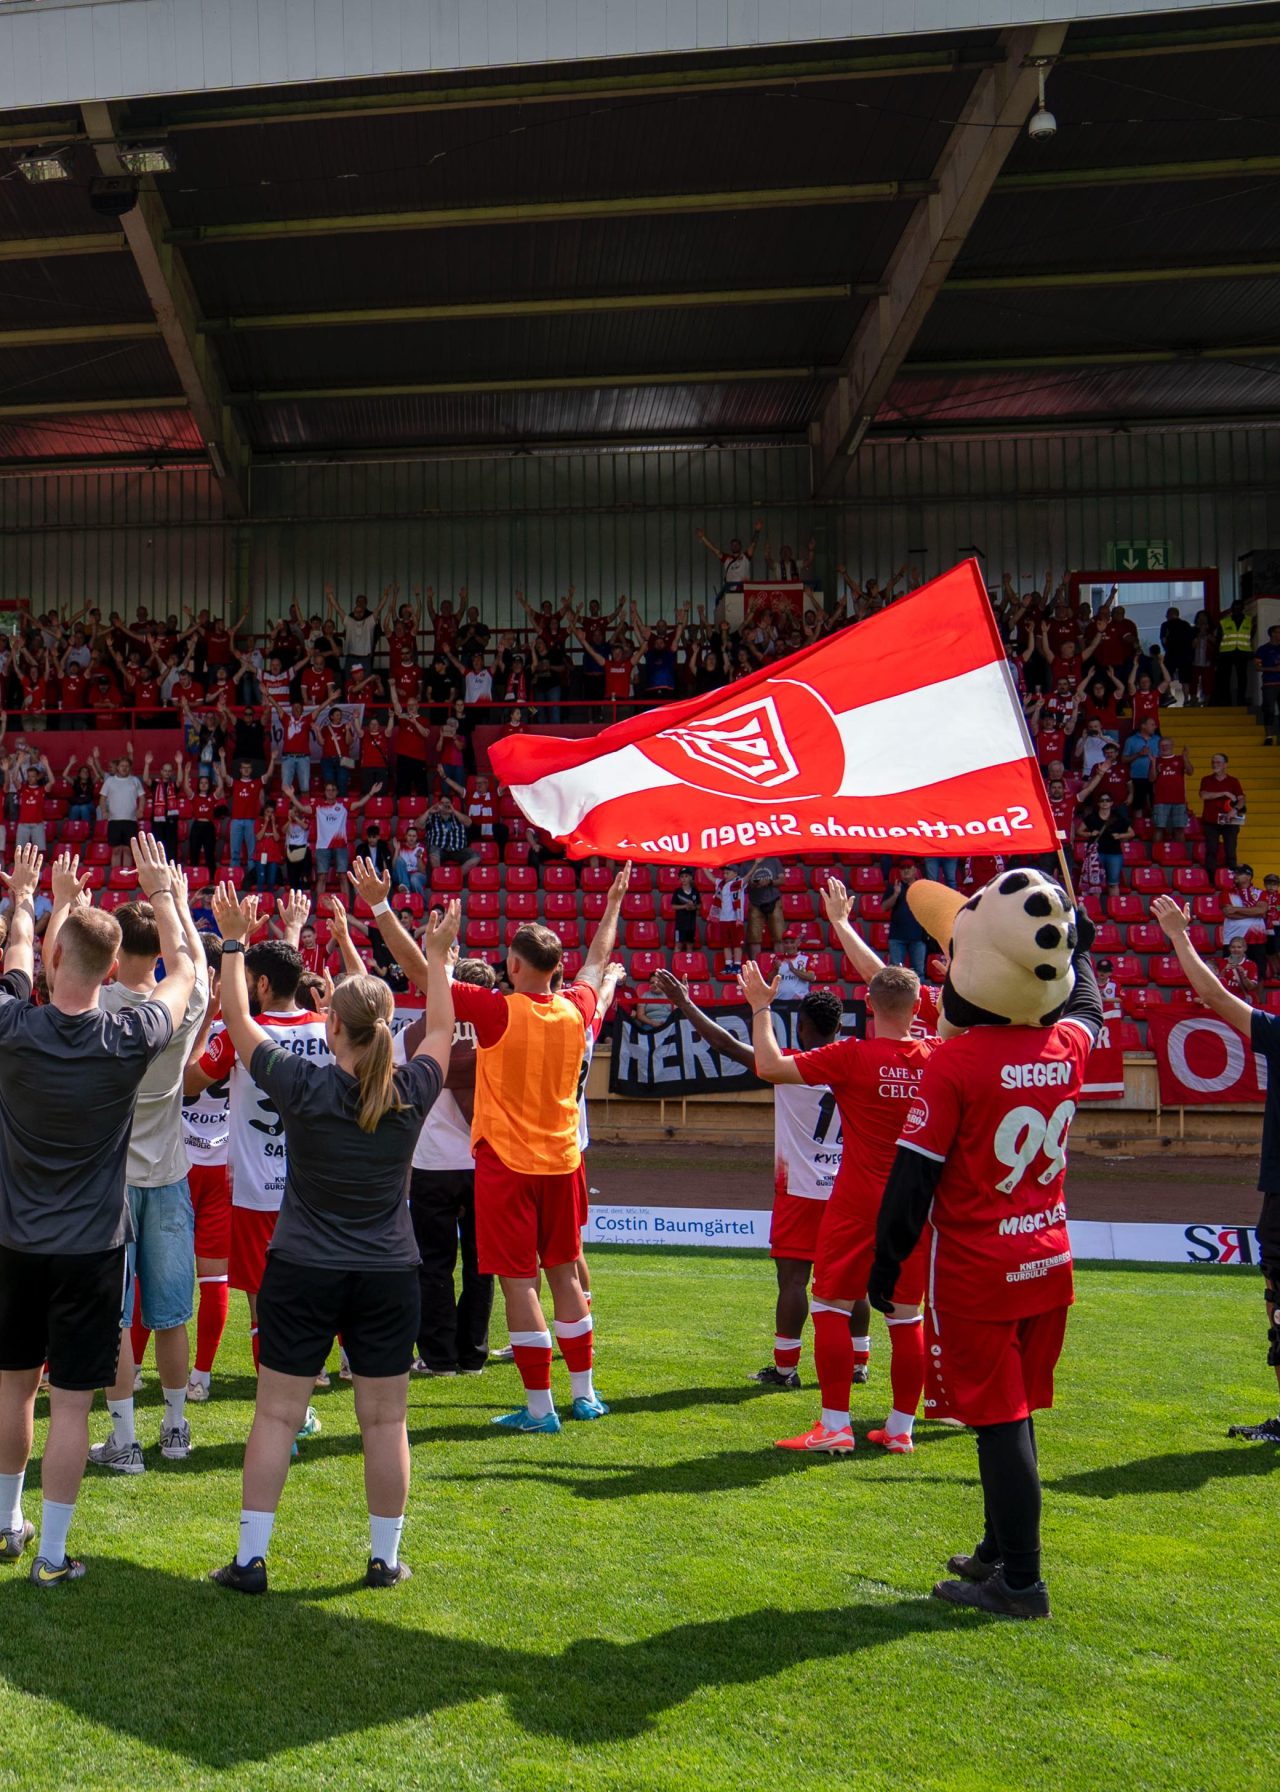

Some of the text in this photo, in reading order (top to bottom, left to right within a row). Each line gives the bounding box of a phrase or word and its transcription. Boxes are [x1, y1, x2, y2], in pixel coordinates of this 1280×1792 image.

[1000, 1061, 1072, 1089] SIEGEN
[994, 1100, 1076, 1194] 99
[595, 1216, 755, 1237] Costin Baumgärtel
[1006, 1268, 1048, 1283] GURDULIC
